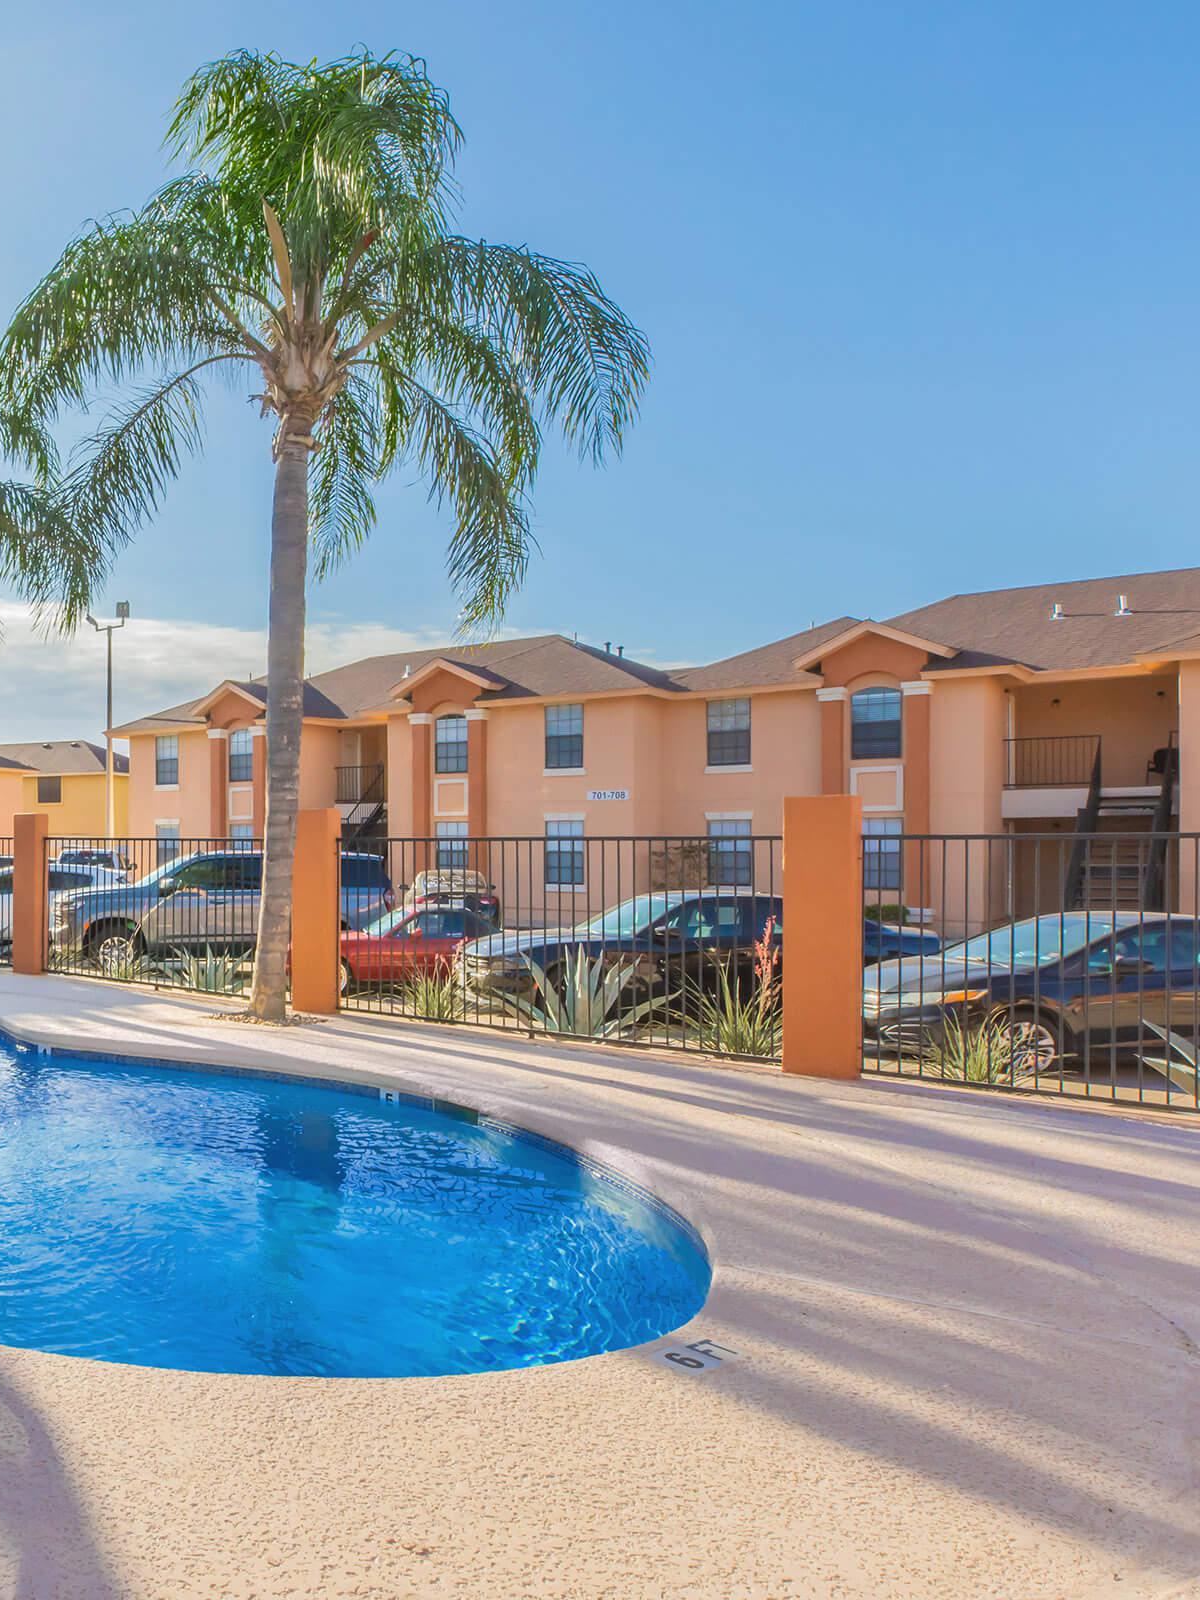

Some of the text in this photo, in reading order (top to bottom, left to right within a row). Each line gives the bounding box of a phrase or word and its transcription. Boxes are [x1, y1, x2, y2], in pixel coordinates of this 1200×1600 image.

[591, 791, 626, 800] 701-708
[664, 1339, 738, 1368] 6 FT
